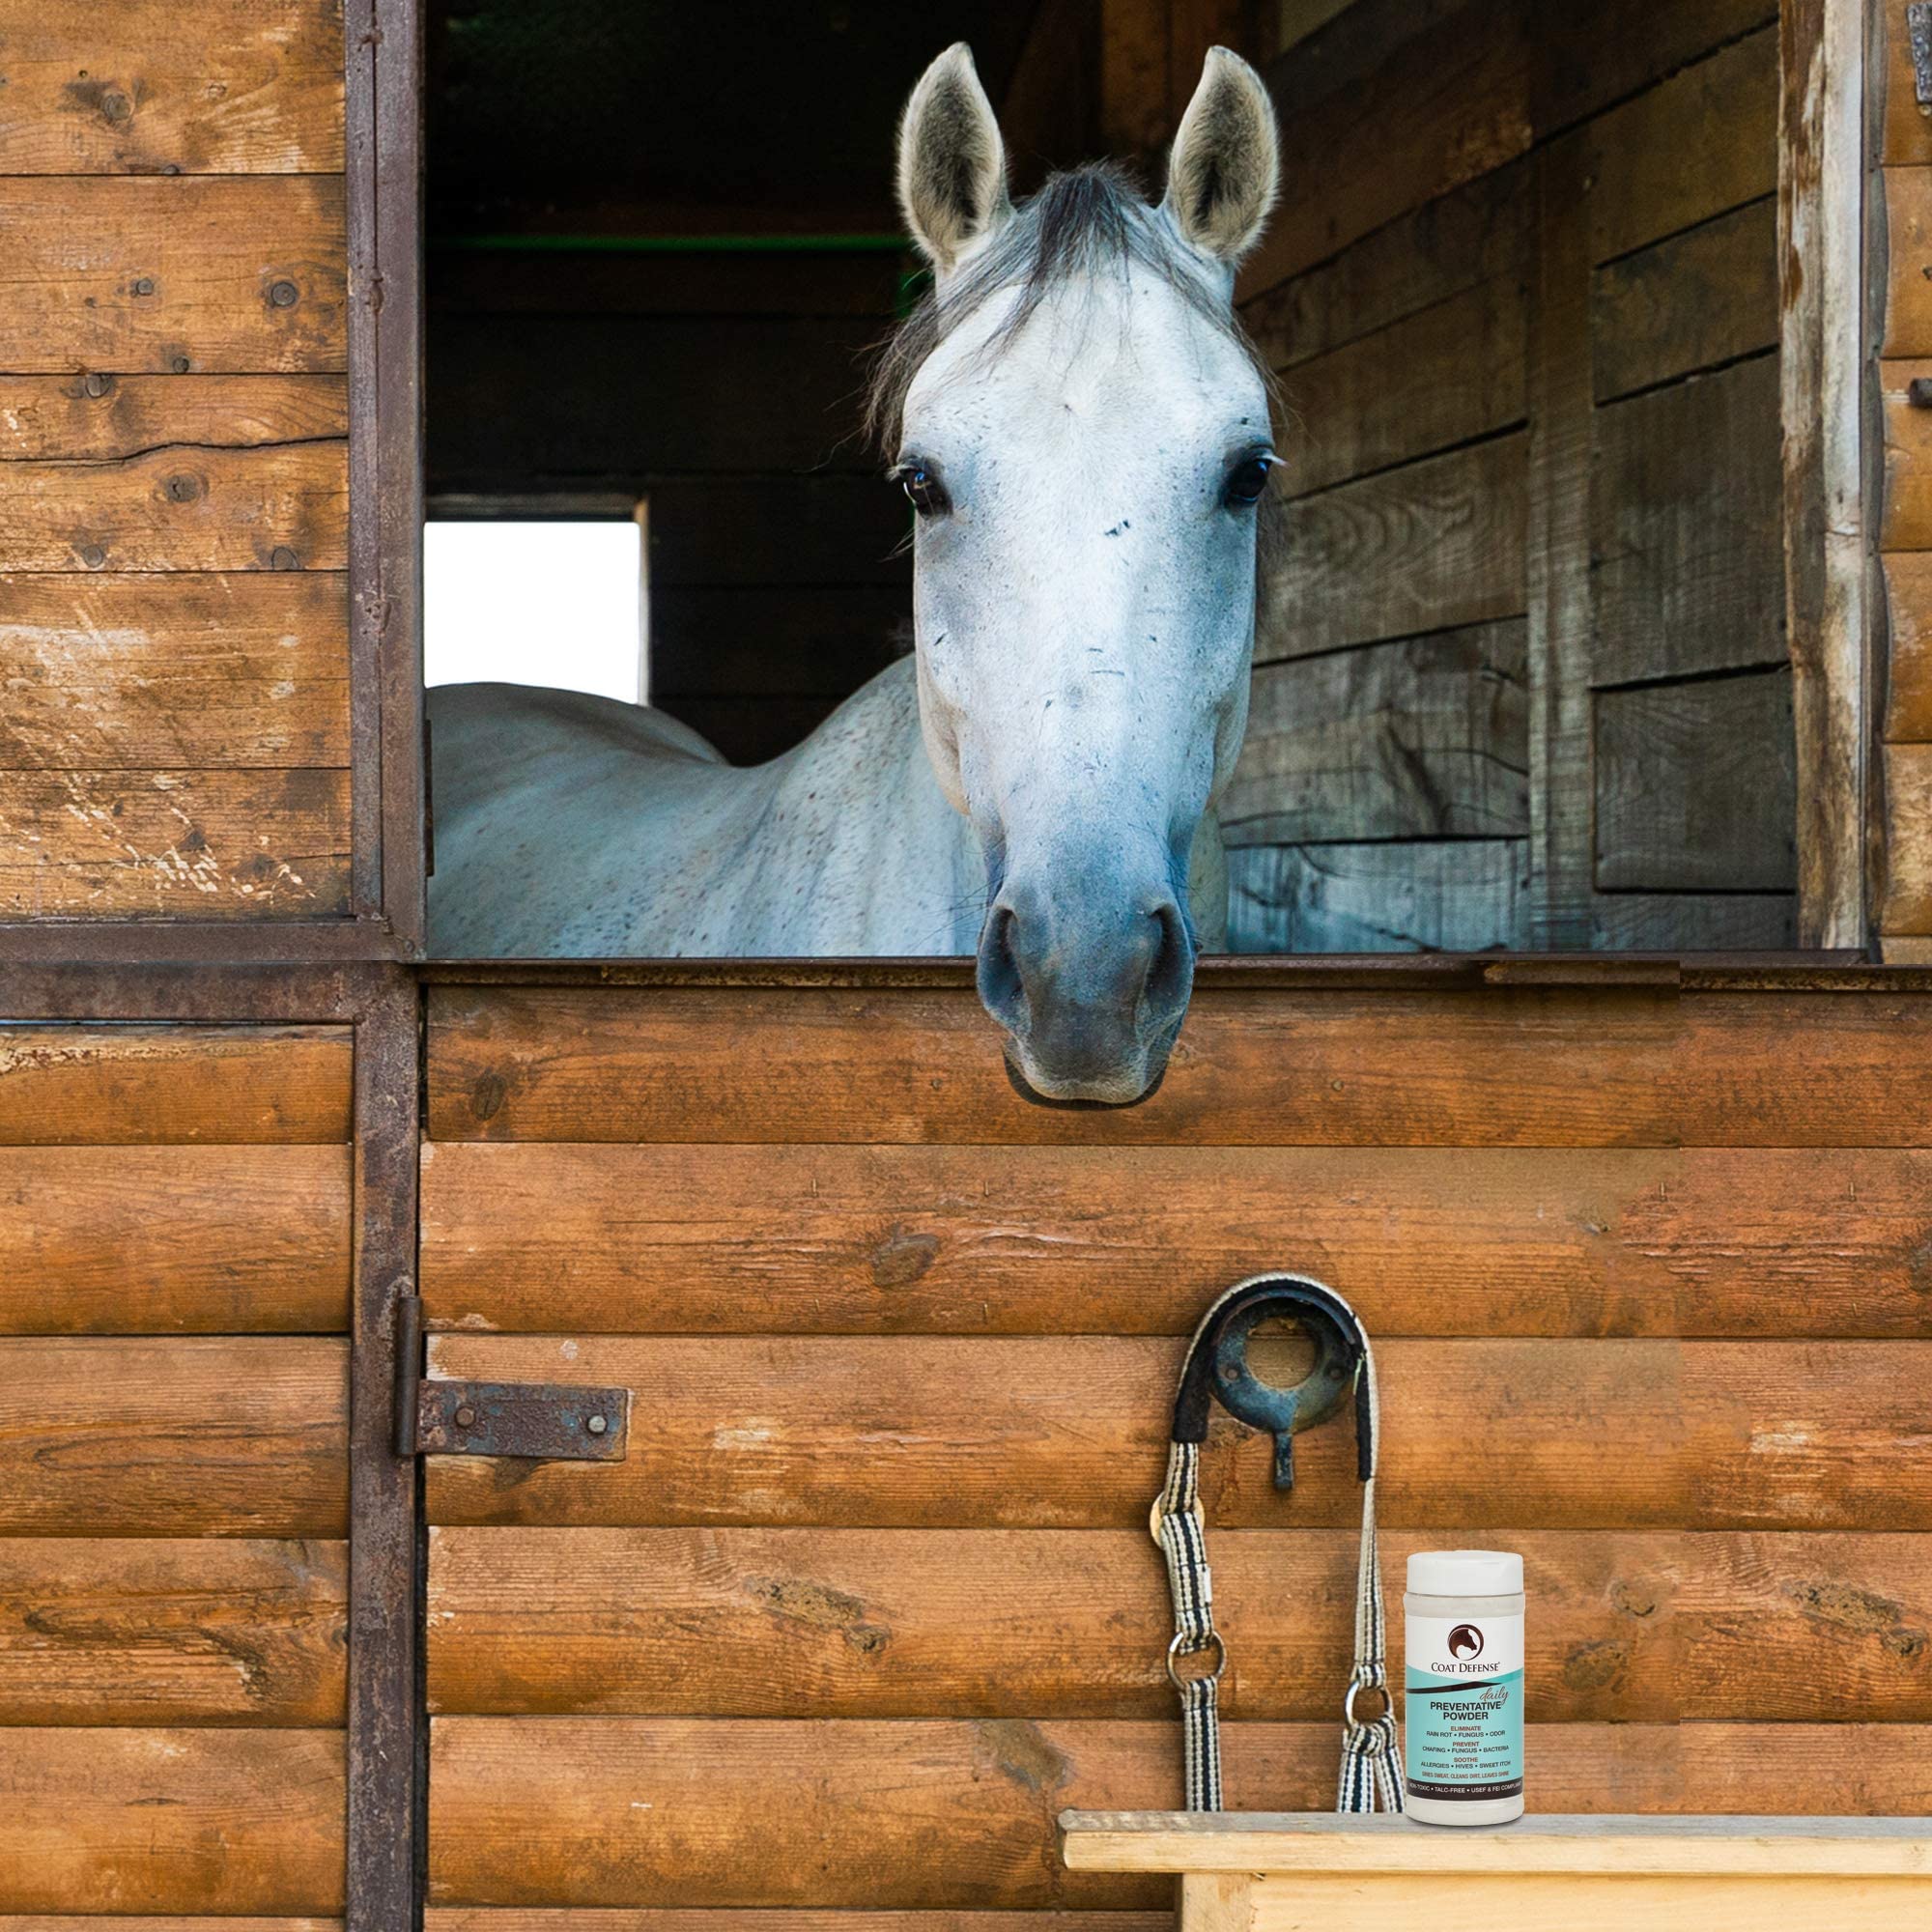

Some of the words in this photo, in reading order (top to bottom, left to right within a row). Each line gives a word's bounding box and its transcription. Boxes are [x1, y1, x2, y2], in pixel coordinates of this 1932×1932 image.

[1431, 1662, 1456, 1672] COAT
[1479, 1686, 1509, 1705] daily
[1430, 1702, 1501, 1710] PREVENTATIVE
[1443, 1712, 1488, 1720] POWDER
